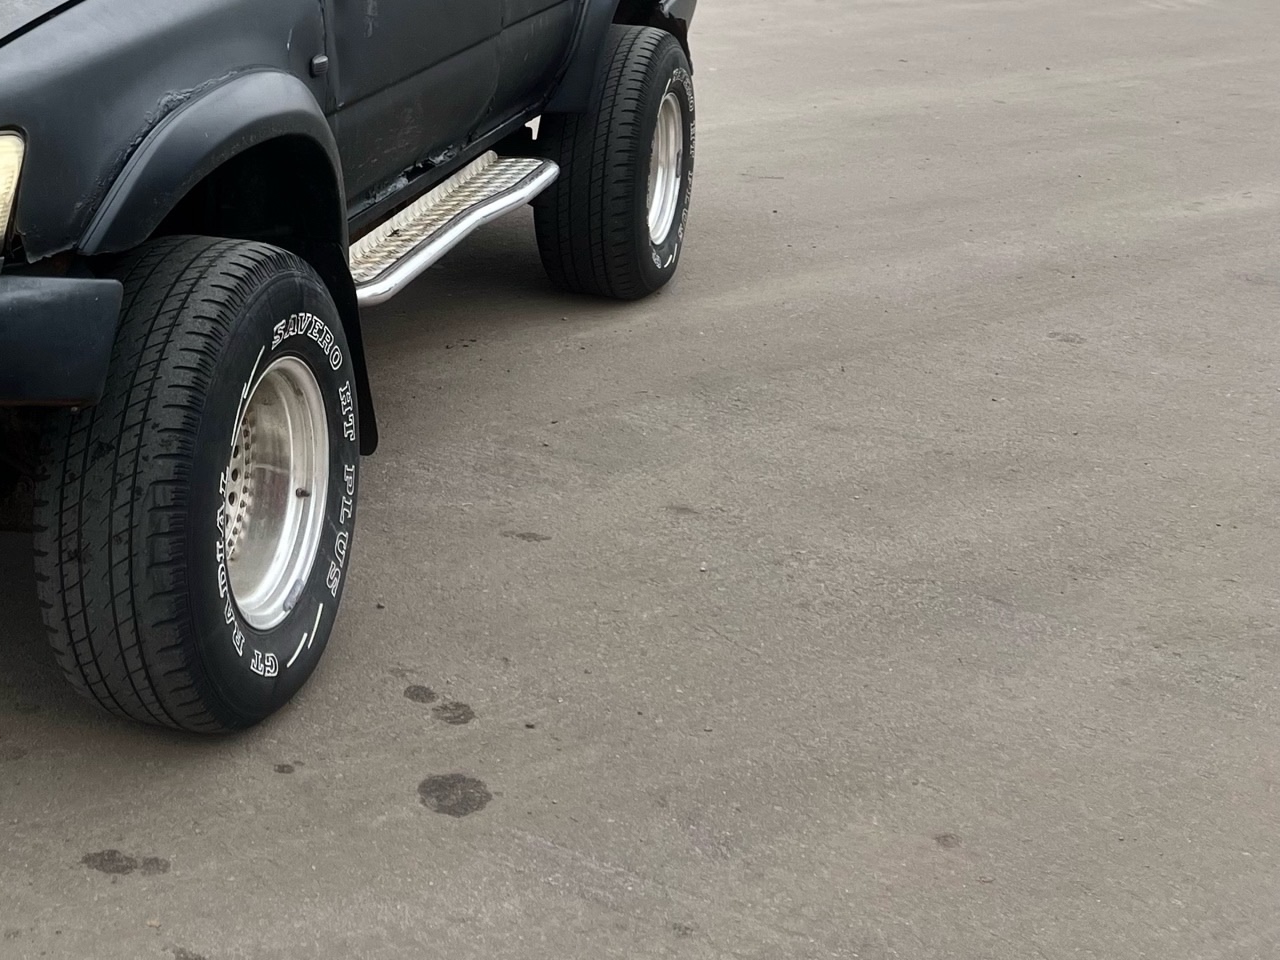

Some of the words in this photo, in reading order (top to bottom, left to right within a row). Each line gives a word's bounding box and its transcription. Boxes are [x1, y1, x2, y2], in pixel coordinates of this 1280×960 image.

[271, 312, 343, 371] SAVERO
[338, 380, 356, 441] HT
[326, 464, 355, 598] PLUS
[250, 650, 279, 677] GT
